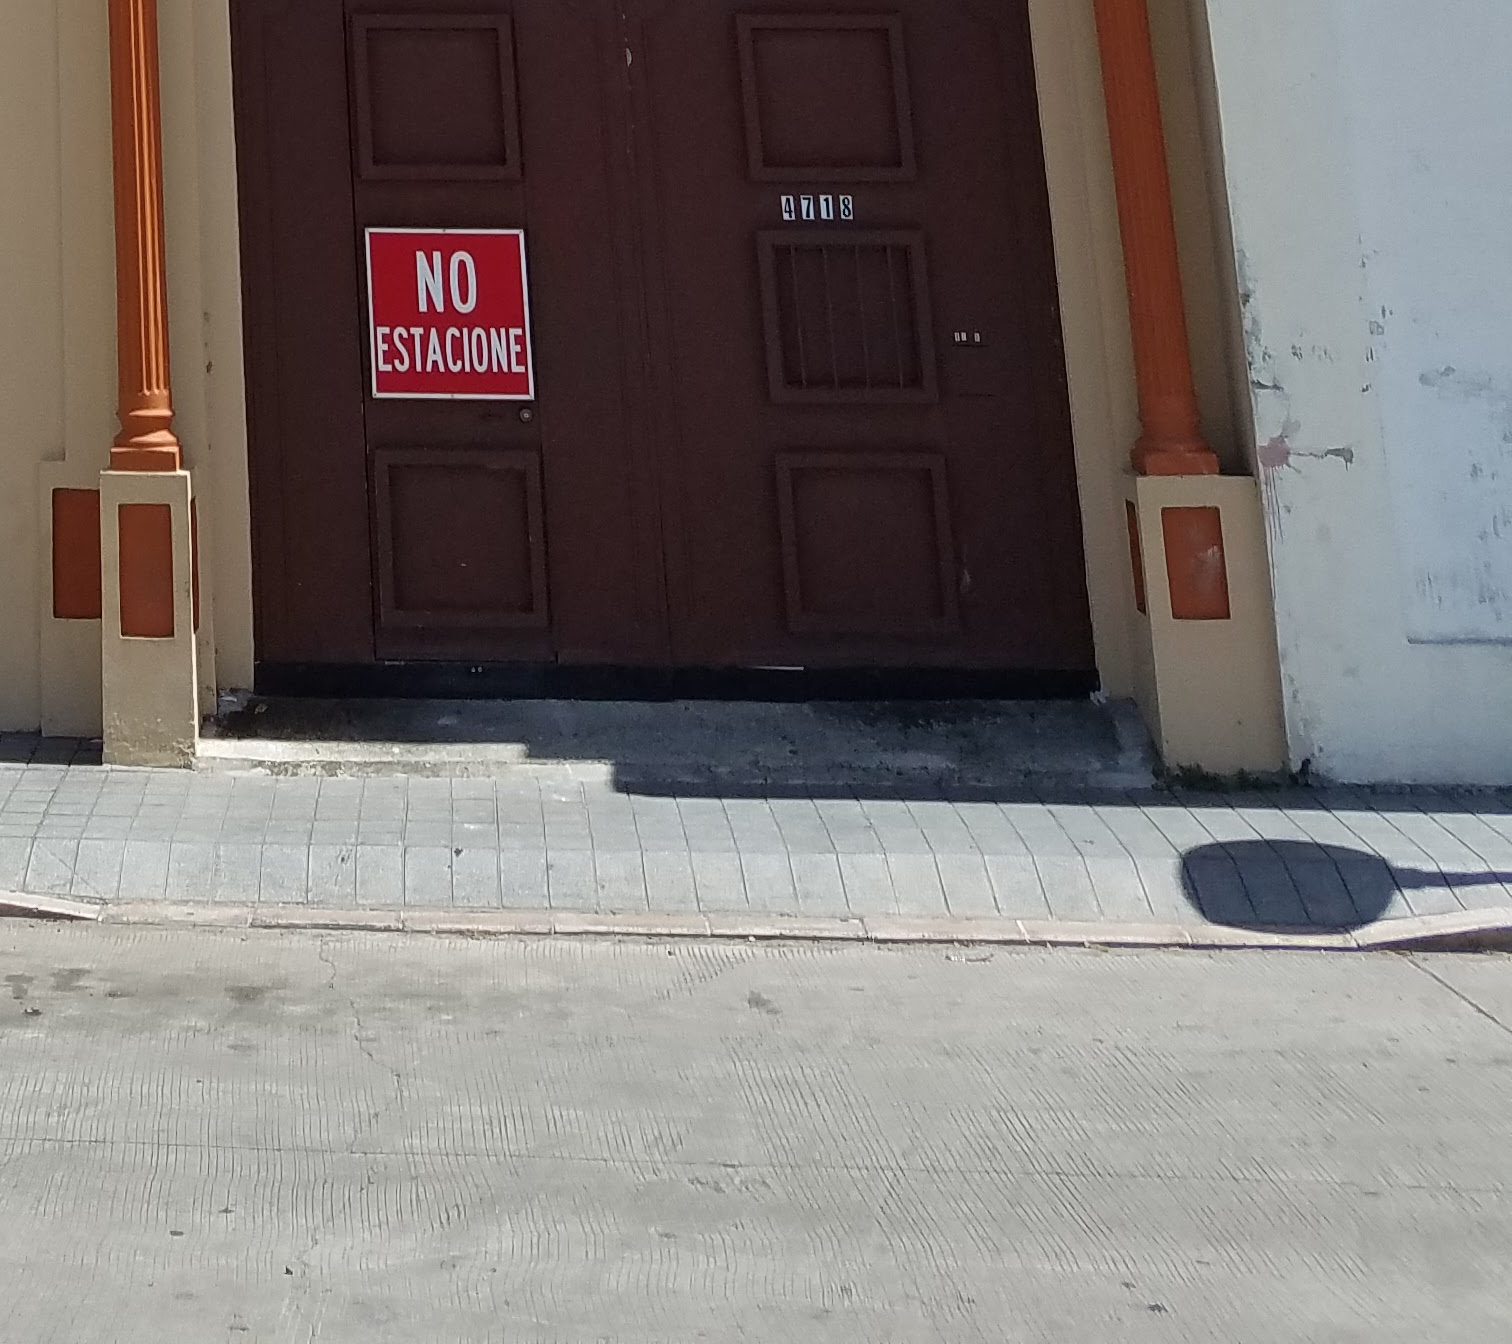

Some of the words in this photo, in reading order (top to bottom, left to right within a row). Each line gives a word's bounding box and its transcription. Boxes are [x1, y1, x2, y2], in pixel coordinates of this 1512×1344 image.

[783, 196, 852, 219] 4718
[415, 250, 478, 314] NO
[376, 326, 526, 374] ESTACIONE
